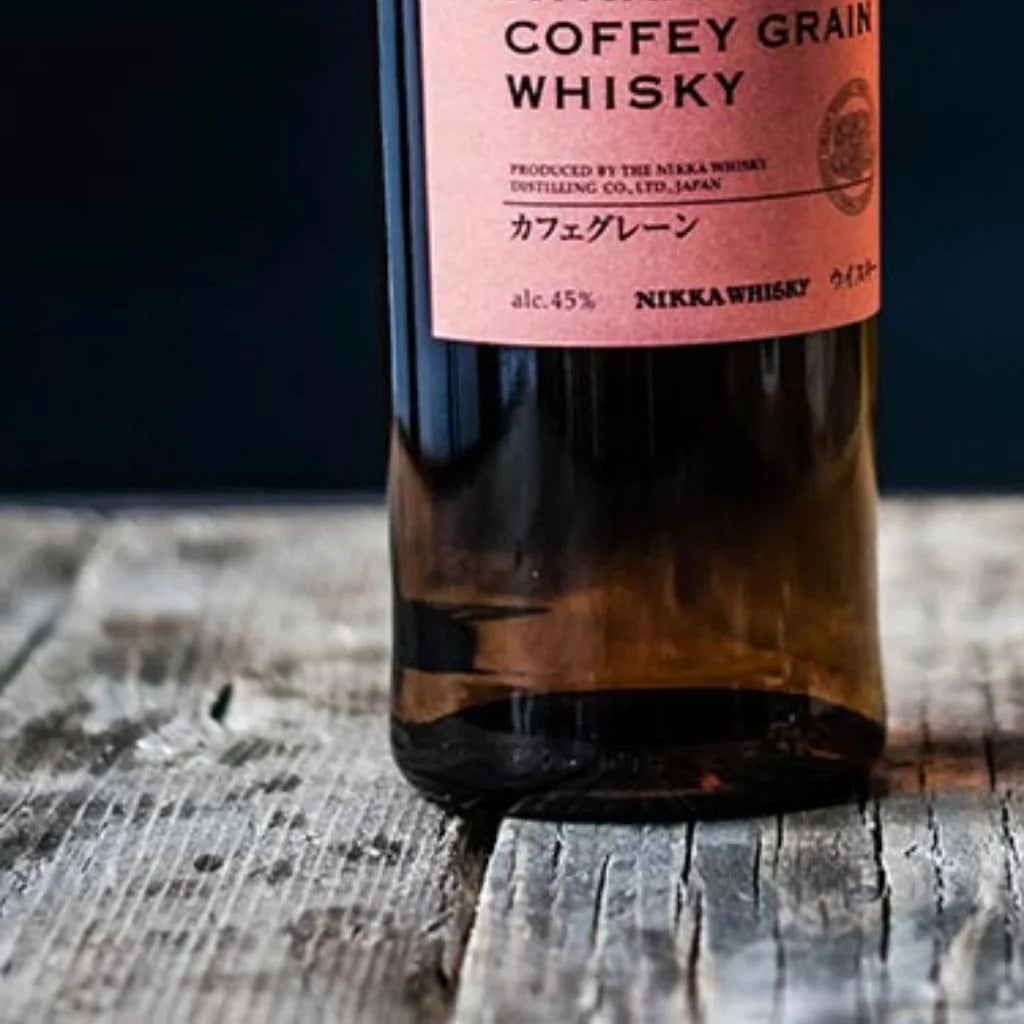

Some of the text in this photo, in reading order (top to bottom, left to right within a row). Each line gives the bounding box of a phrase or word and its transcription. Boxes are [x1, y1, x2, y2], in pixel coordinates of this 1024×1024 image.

[505, 0, 873, 56] COFFEY GRAIN
[506, 71, 745, 110] WHISKY
[510, 157, 767, 178] PRODUCED BY THE NIKKA WHISKY
[509, 179, 598, 194] DISTILLING
[675, 177, 722, 195] JAPAN
[509, 212, 700, 243] カフェグレーン
[509, 289, 597, 311] alc.45%
[634, 277, 811, 310] NIKKA WHISKY
